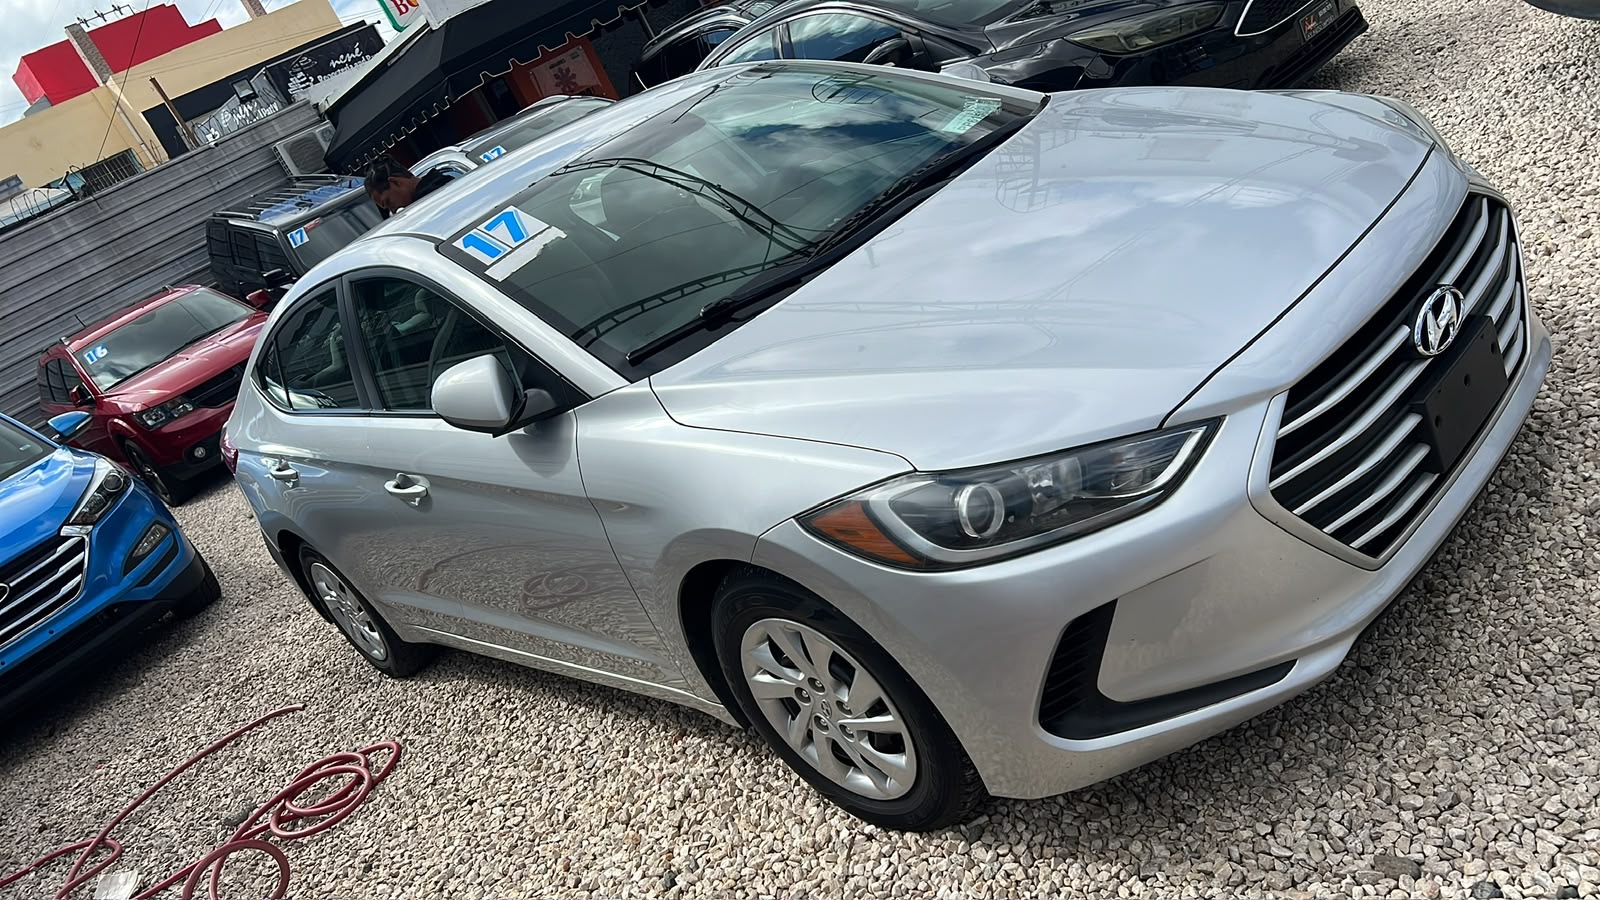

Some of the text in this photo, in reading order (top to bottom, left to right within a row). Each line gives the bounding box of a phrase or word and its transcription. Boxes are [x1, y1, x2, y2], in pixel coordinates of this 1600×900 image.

[483, 147, 503, 161] 17
[289, 228, 306, 247] 17
[462, 208, 530, 259] 17
[85, 343, 108, 362] 16
